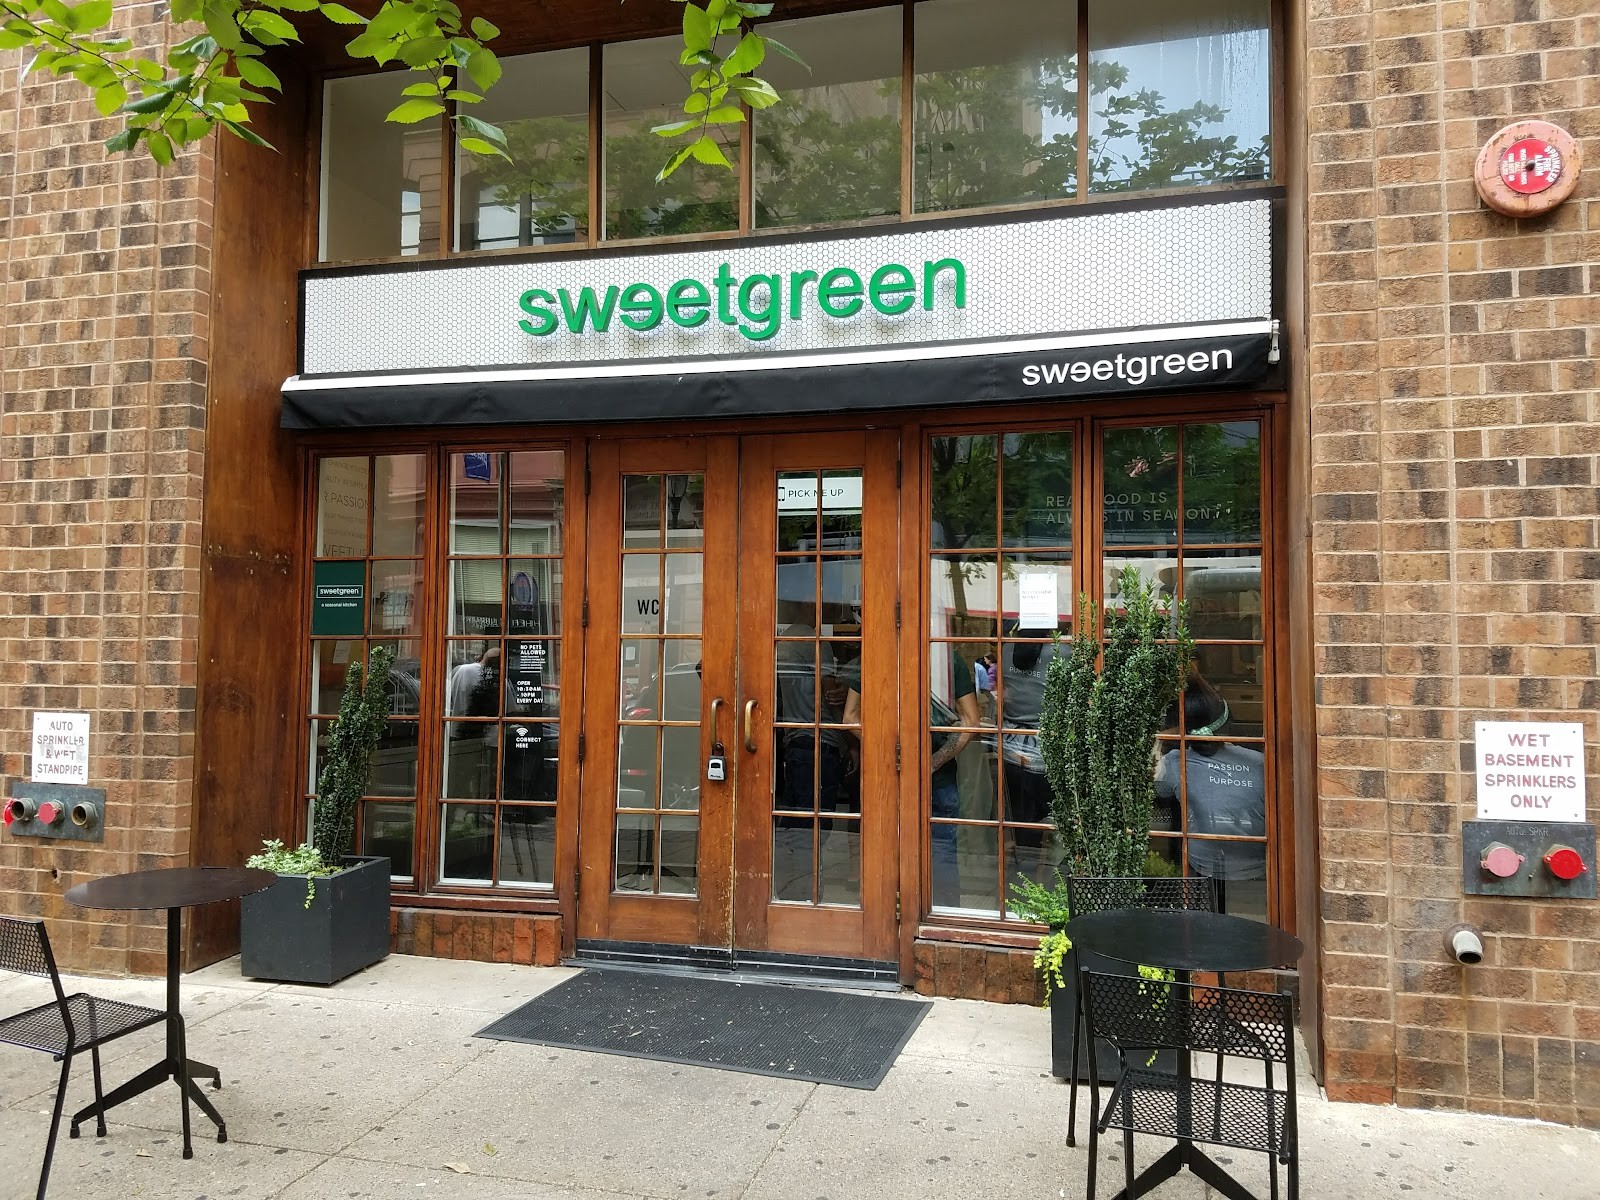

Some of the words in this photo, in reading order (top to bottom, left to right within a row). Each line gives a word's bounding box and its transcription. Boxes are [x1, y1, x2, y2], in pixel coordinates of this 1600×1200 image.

[1534, 154, 1544, 177] ALARM
[1542, 157, 1552, 172] FIRE
[1544, 145, 1561, 183] SPRINKLER
[518, 257, 967, 341] sweetgreen
[1021, 348, 1233, 386] sweetgreen
[788, 490, 811, 498] PICK
[830, 489, 844, 497] UP
[1046, 496, 1072, 507] REA
[1104, 493, 1142, 505] OOD
[1150, 492, 1167, 504] IS
[1117, 510, 1134, 522] IN
[1142, 508, 1215, 521] SEAON.
[319, 587, 359, 596] sweetgreen
[637, 599, 660, 615] WC
[49, 721, 73, 731] AUTO
[37, 735, 85, 746] SPRINKLER
[1508, 733, 1550, 747] WET
[45, 749, 53, 759] &
[1485, 753, 1574, 768] BASEMENT
[37, 763, 83, 775] STANDPIPE
[1208, 763, 1250, 772] PASSION
[1209, 776, 1254, 788] PURPOSE
[1485, 774, 1577, 789] SPRINKLERS
[1510, 794, 1552, 809] ONLY
